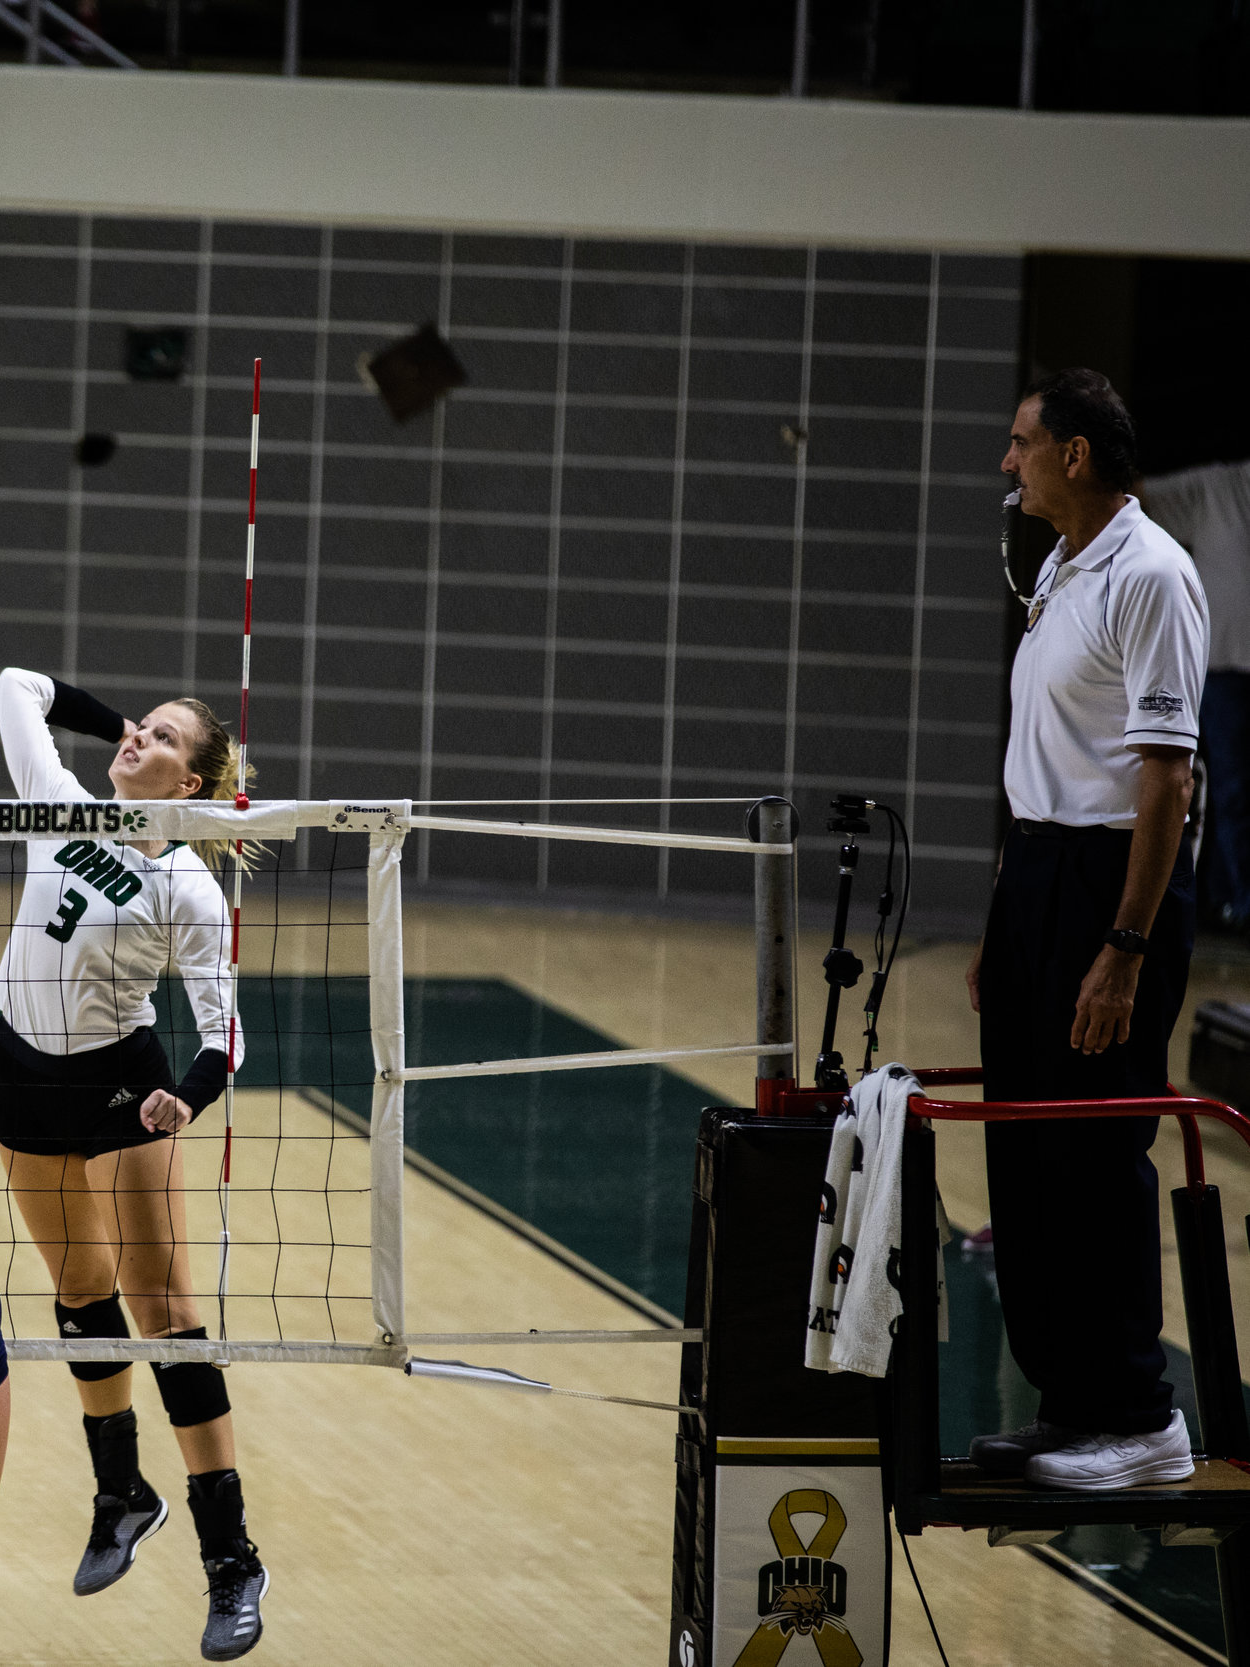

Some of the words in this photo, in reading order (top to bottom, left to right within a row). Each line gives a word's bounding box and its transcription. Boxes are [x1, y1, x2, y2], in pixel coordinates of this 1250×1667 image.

[54, 839, 143, 907] OHIO
[45, 888, 88, 943] 3
[757, 1556, 847, 1617] OHIO
